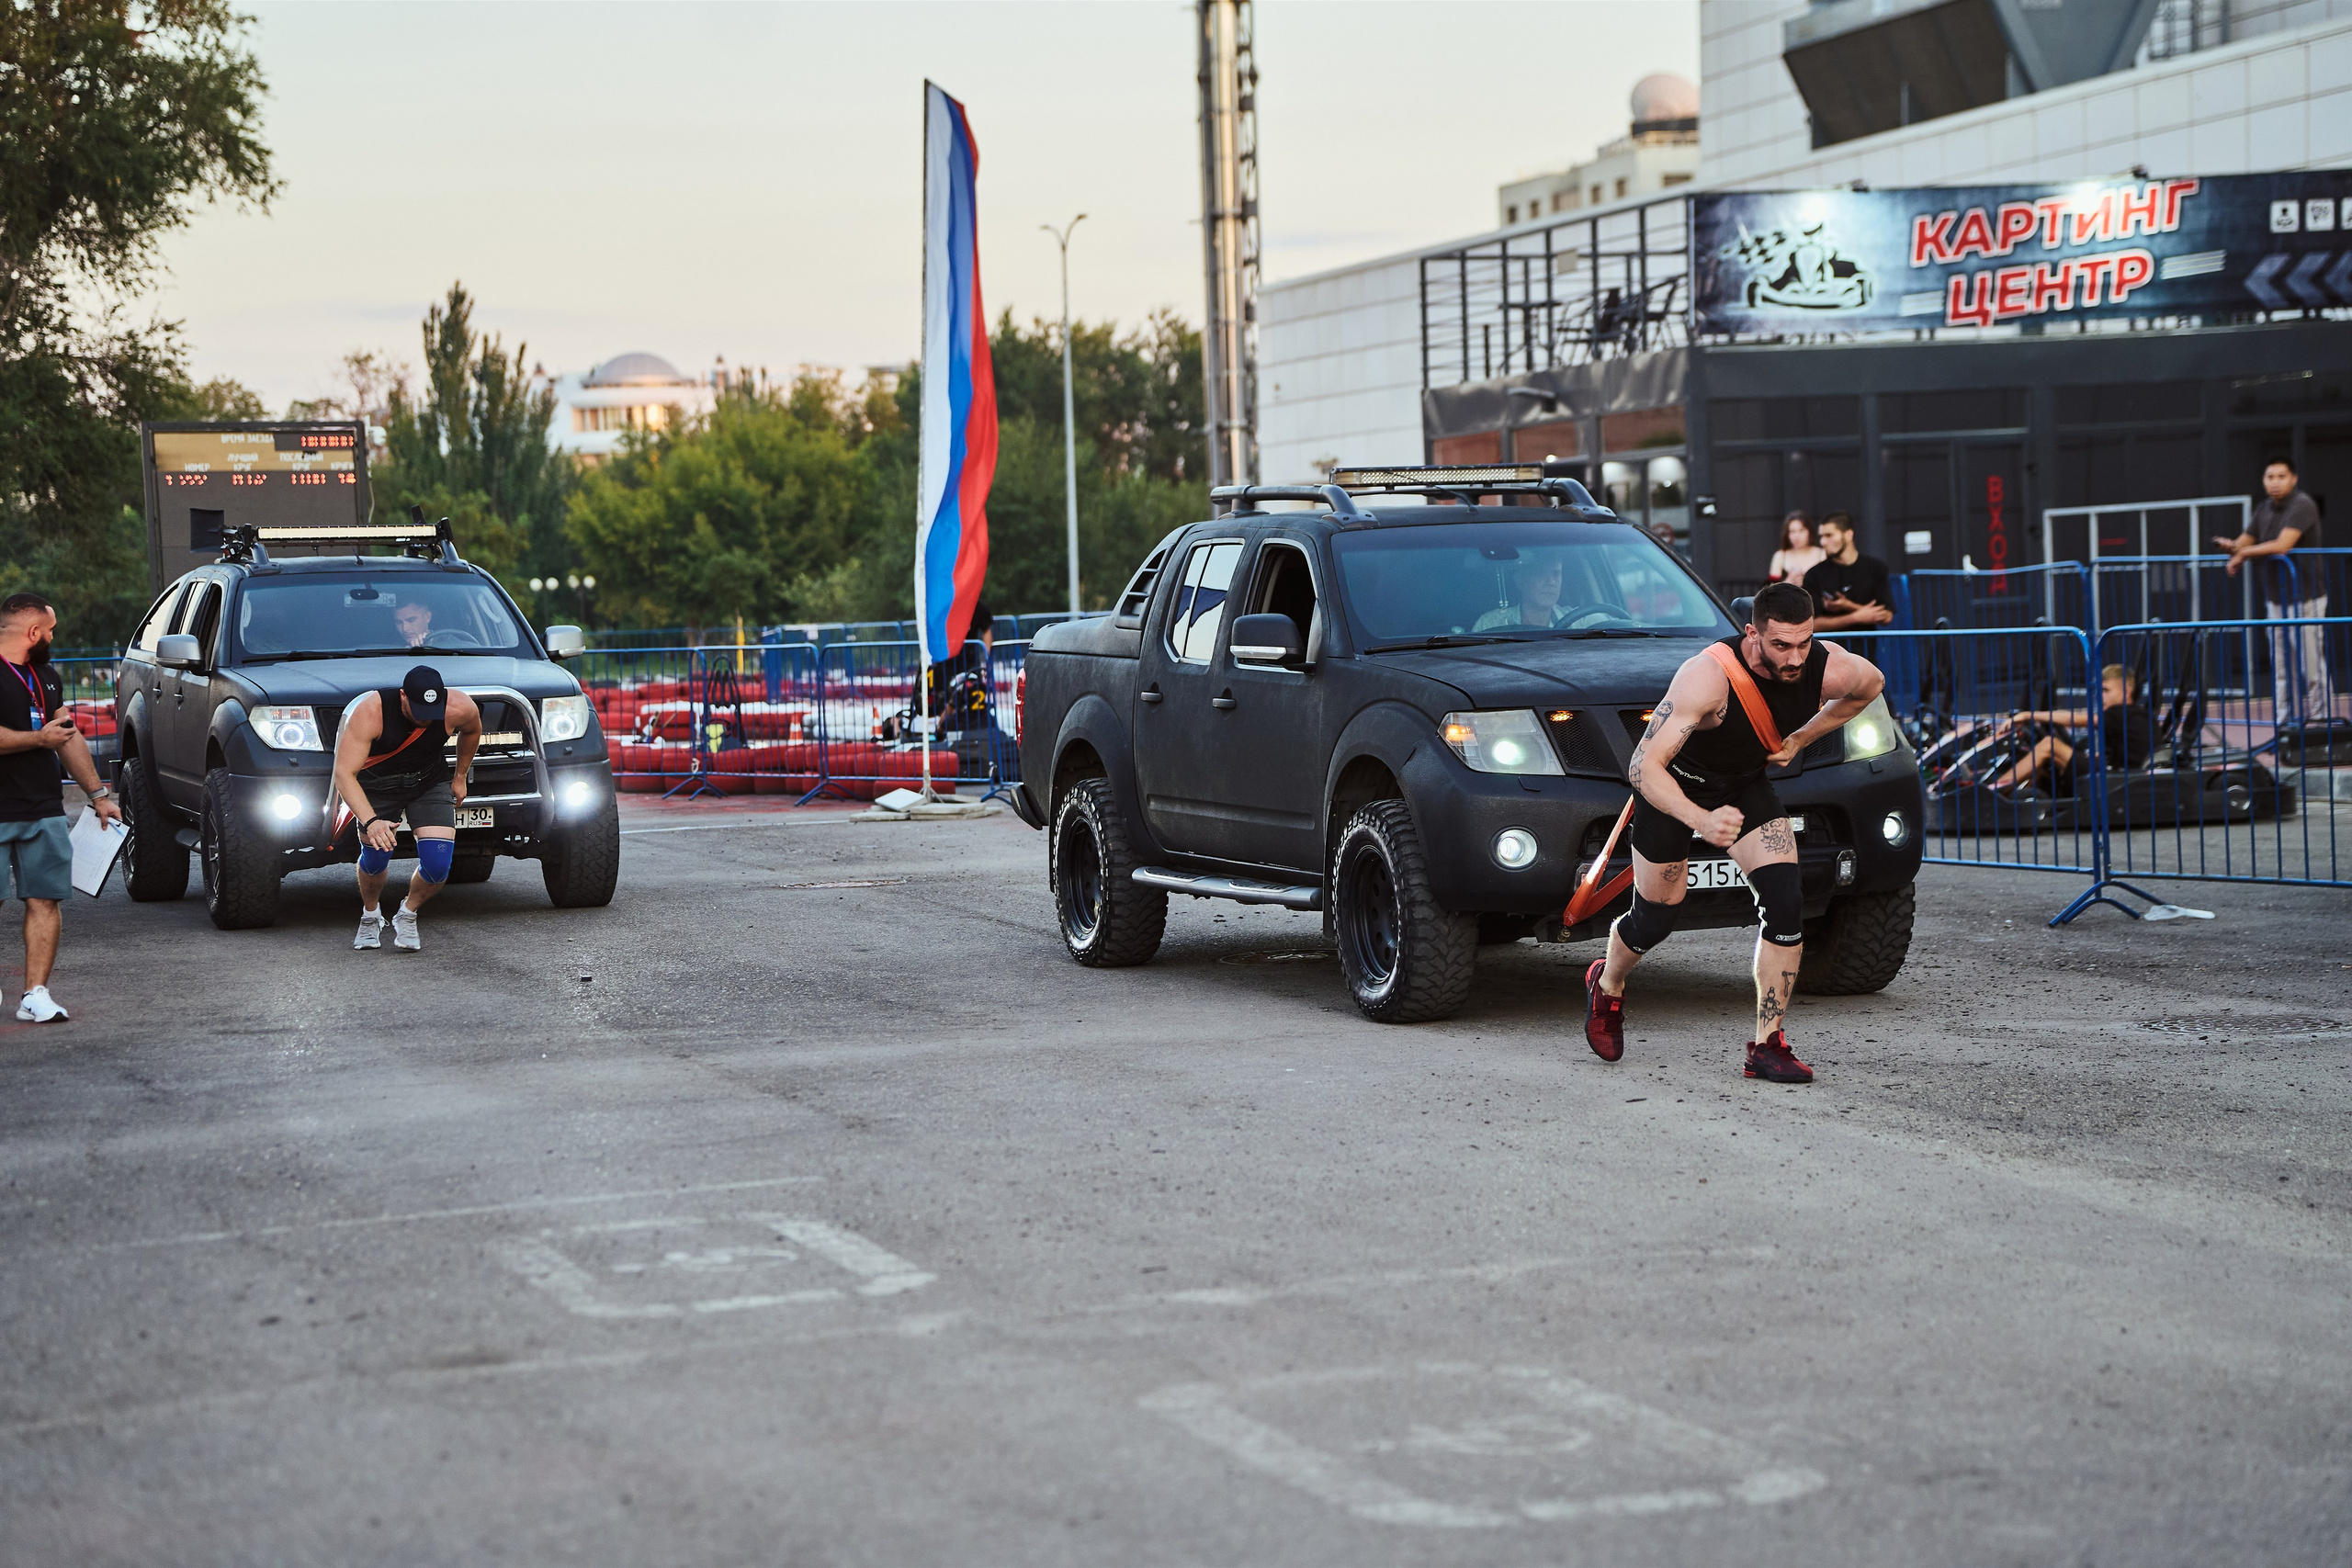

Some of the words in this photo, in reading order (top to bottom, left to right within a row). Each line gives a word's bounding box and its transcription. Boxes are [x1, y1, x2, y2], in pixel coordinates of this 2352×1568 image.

[1910, 178, 2199, 268] КАРТИНГ
[1945, 248, 2154, 328] ЦЕНТР
[971, 691, 986, 710] 2
[470, 808, 488, 820] 30
